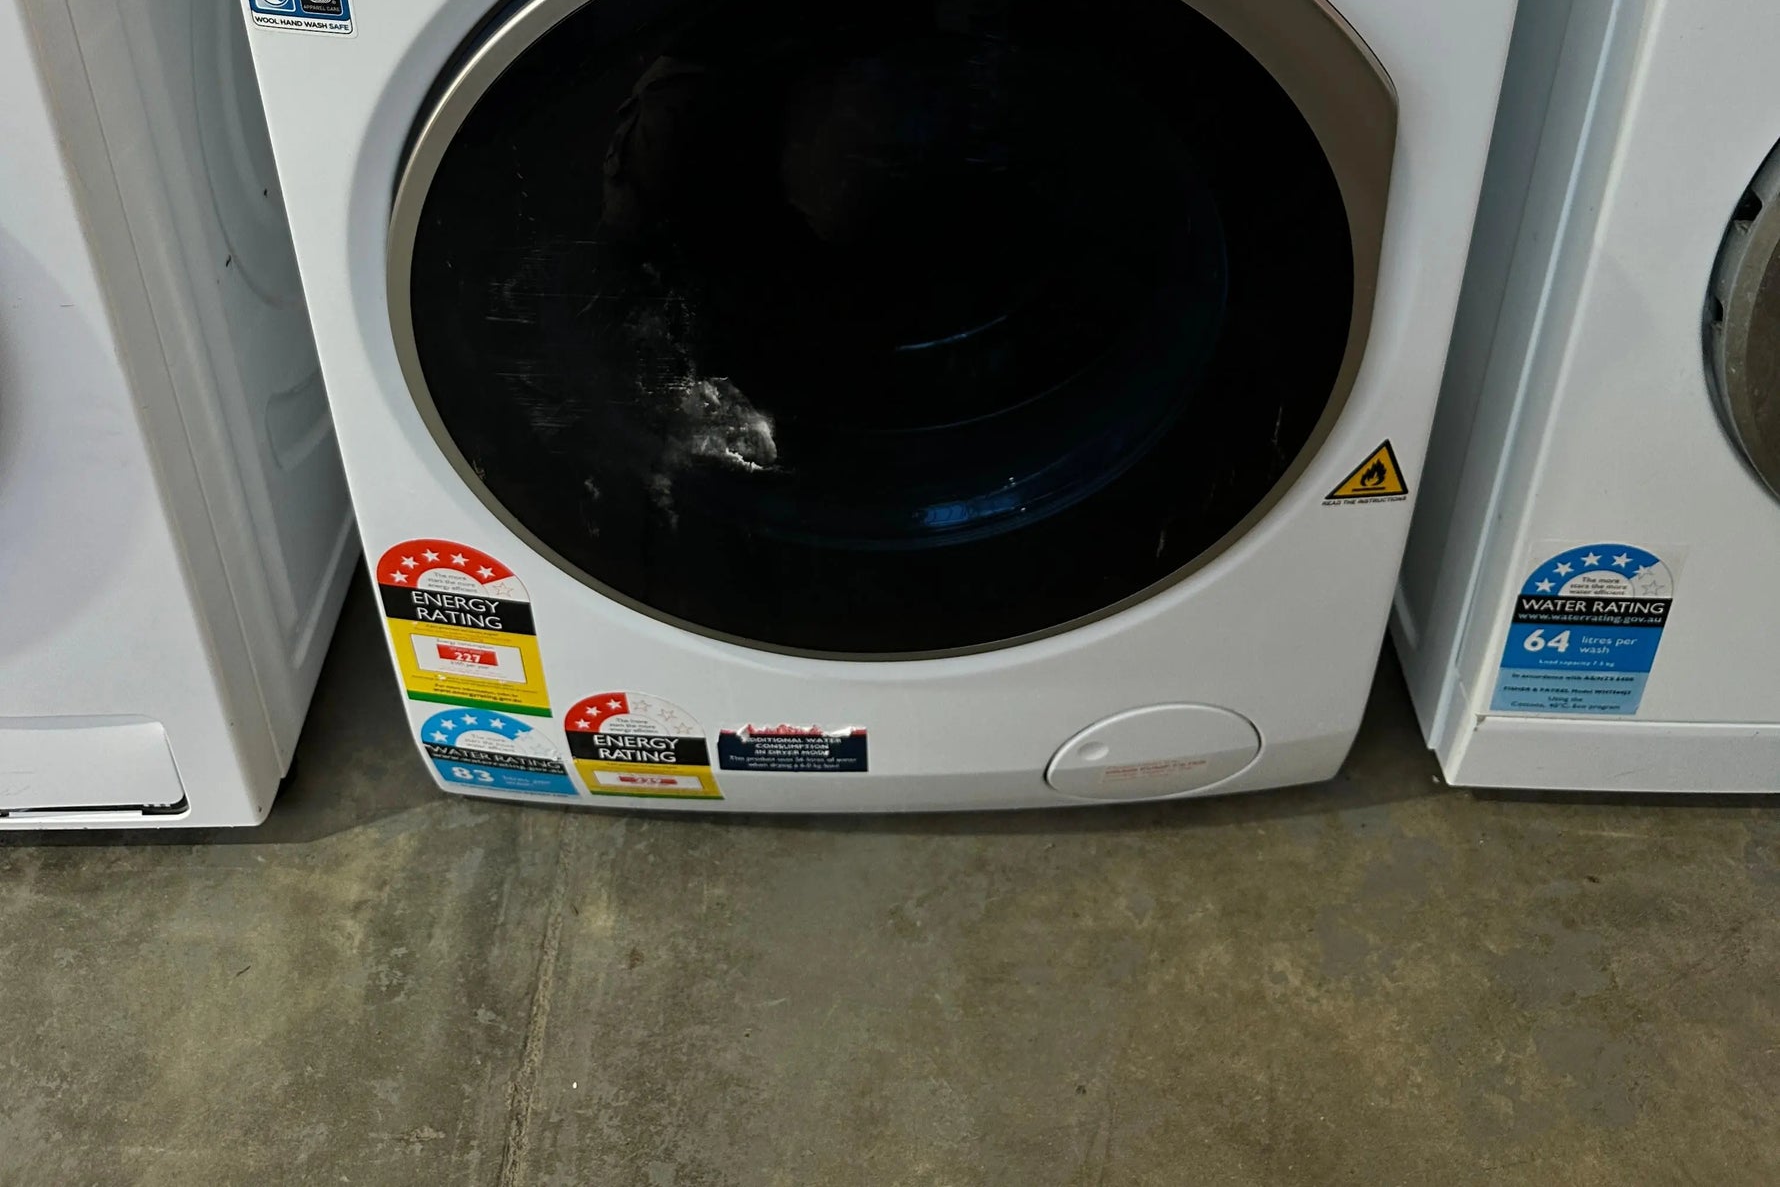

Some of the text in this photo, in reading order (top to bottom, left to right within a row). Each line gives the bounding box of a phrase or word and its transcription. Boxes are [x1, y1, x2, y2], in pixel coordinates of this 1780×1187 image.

[255, 15, 350, 31] WOOL HAND WASH SAFE
[411, 590, 500, 614] ENERGY
[1522, 598, 1666, 614] WATER RATING
[416, 606, 503, 630] RATING
[1518, 613, 1662, 625] www.waterrating.gov.au
[1523, 628, 1571, 653] 64
[1581, 635, 1638, 647] litres per
[454, 651, 482, 664] 227
[1579, 646, 1610, 654] wash
[593, 734, 679, 750] ENERGY
[424, 743, 491, 761] WATER
[494, 754, 561, 770] RATING
[599, 748, 677, 763] RATING
[452, 766, 495, 782] 83
